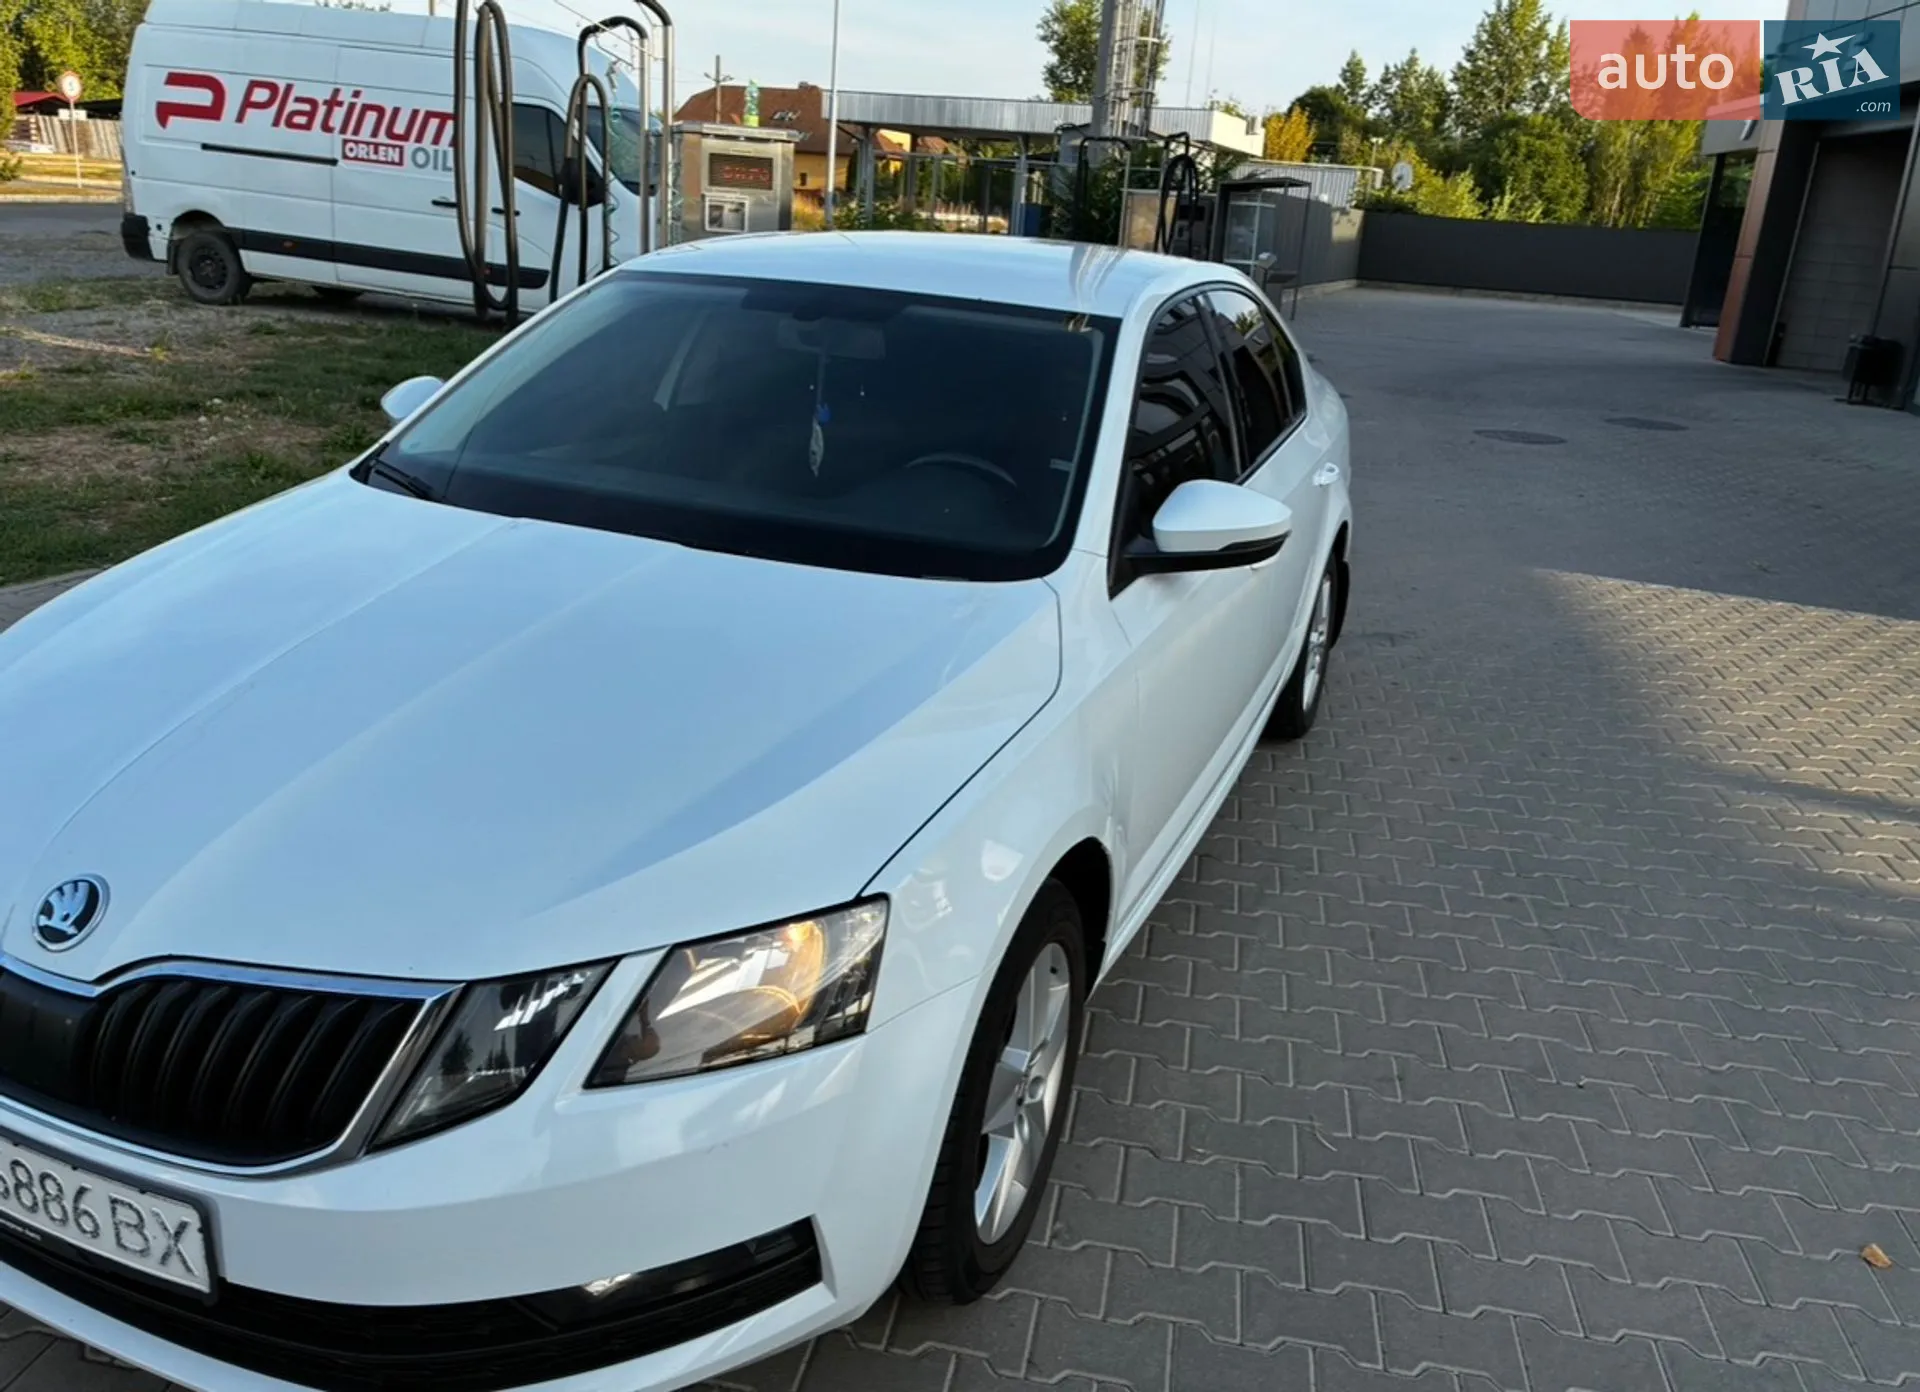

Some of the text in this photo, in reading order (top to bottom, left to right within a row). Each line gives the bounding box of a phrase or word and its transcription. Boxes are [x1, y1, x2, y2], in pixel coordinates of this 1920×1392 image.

[234, 79, 456, 147] Platinum
[345, 142, 454, 172] ORLEN OIL
[108, 1193, 199, 1277] BX
